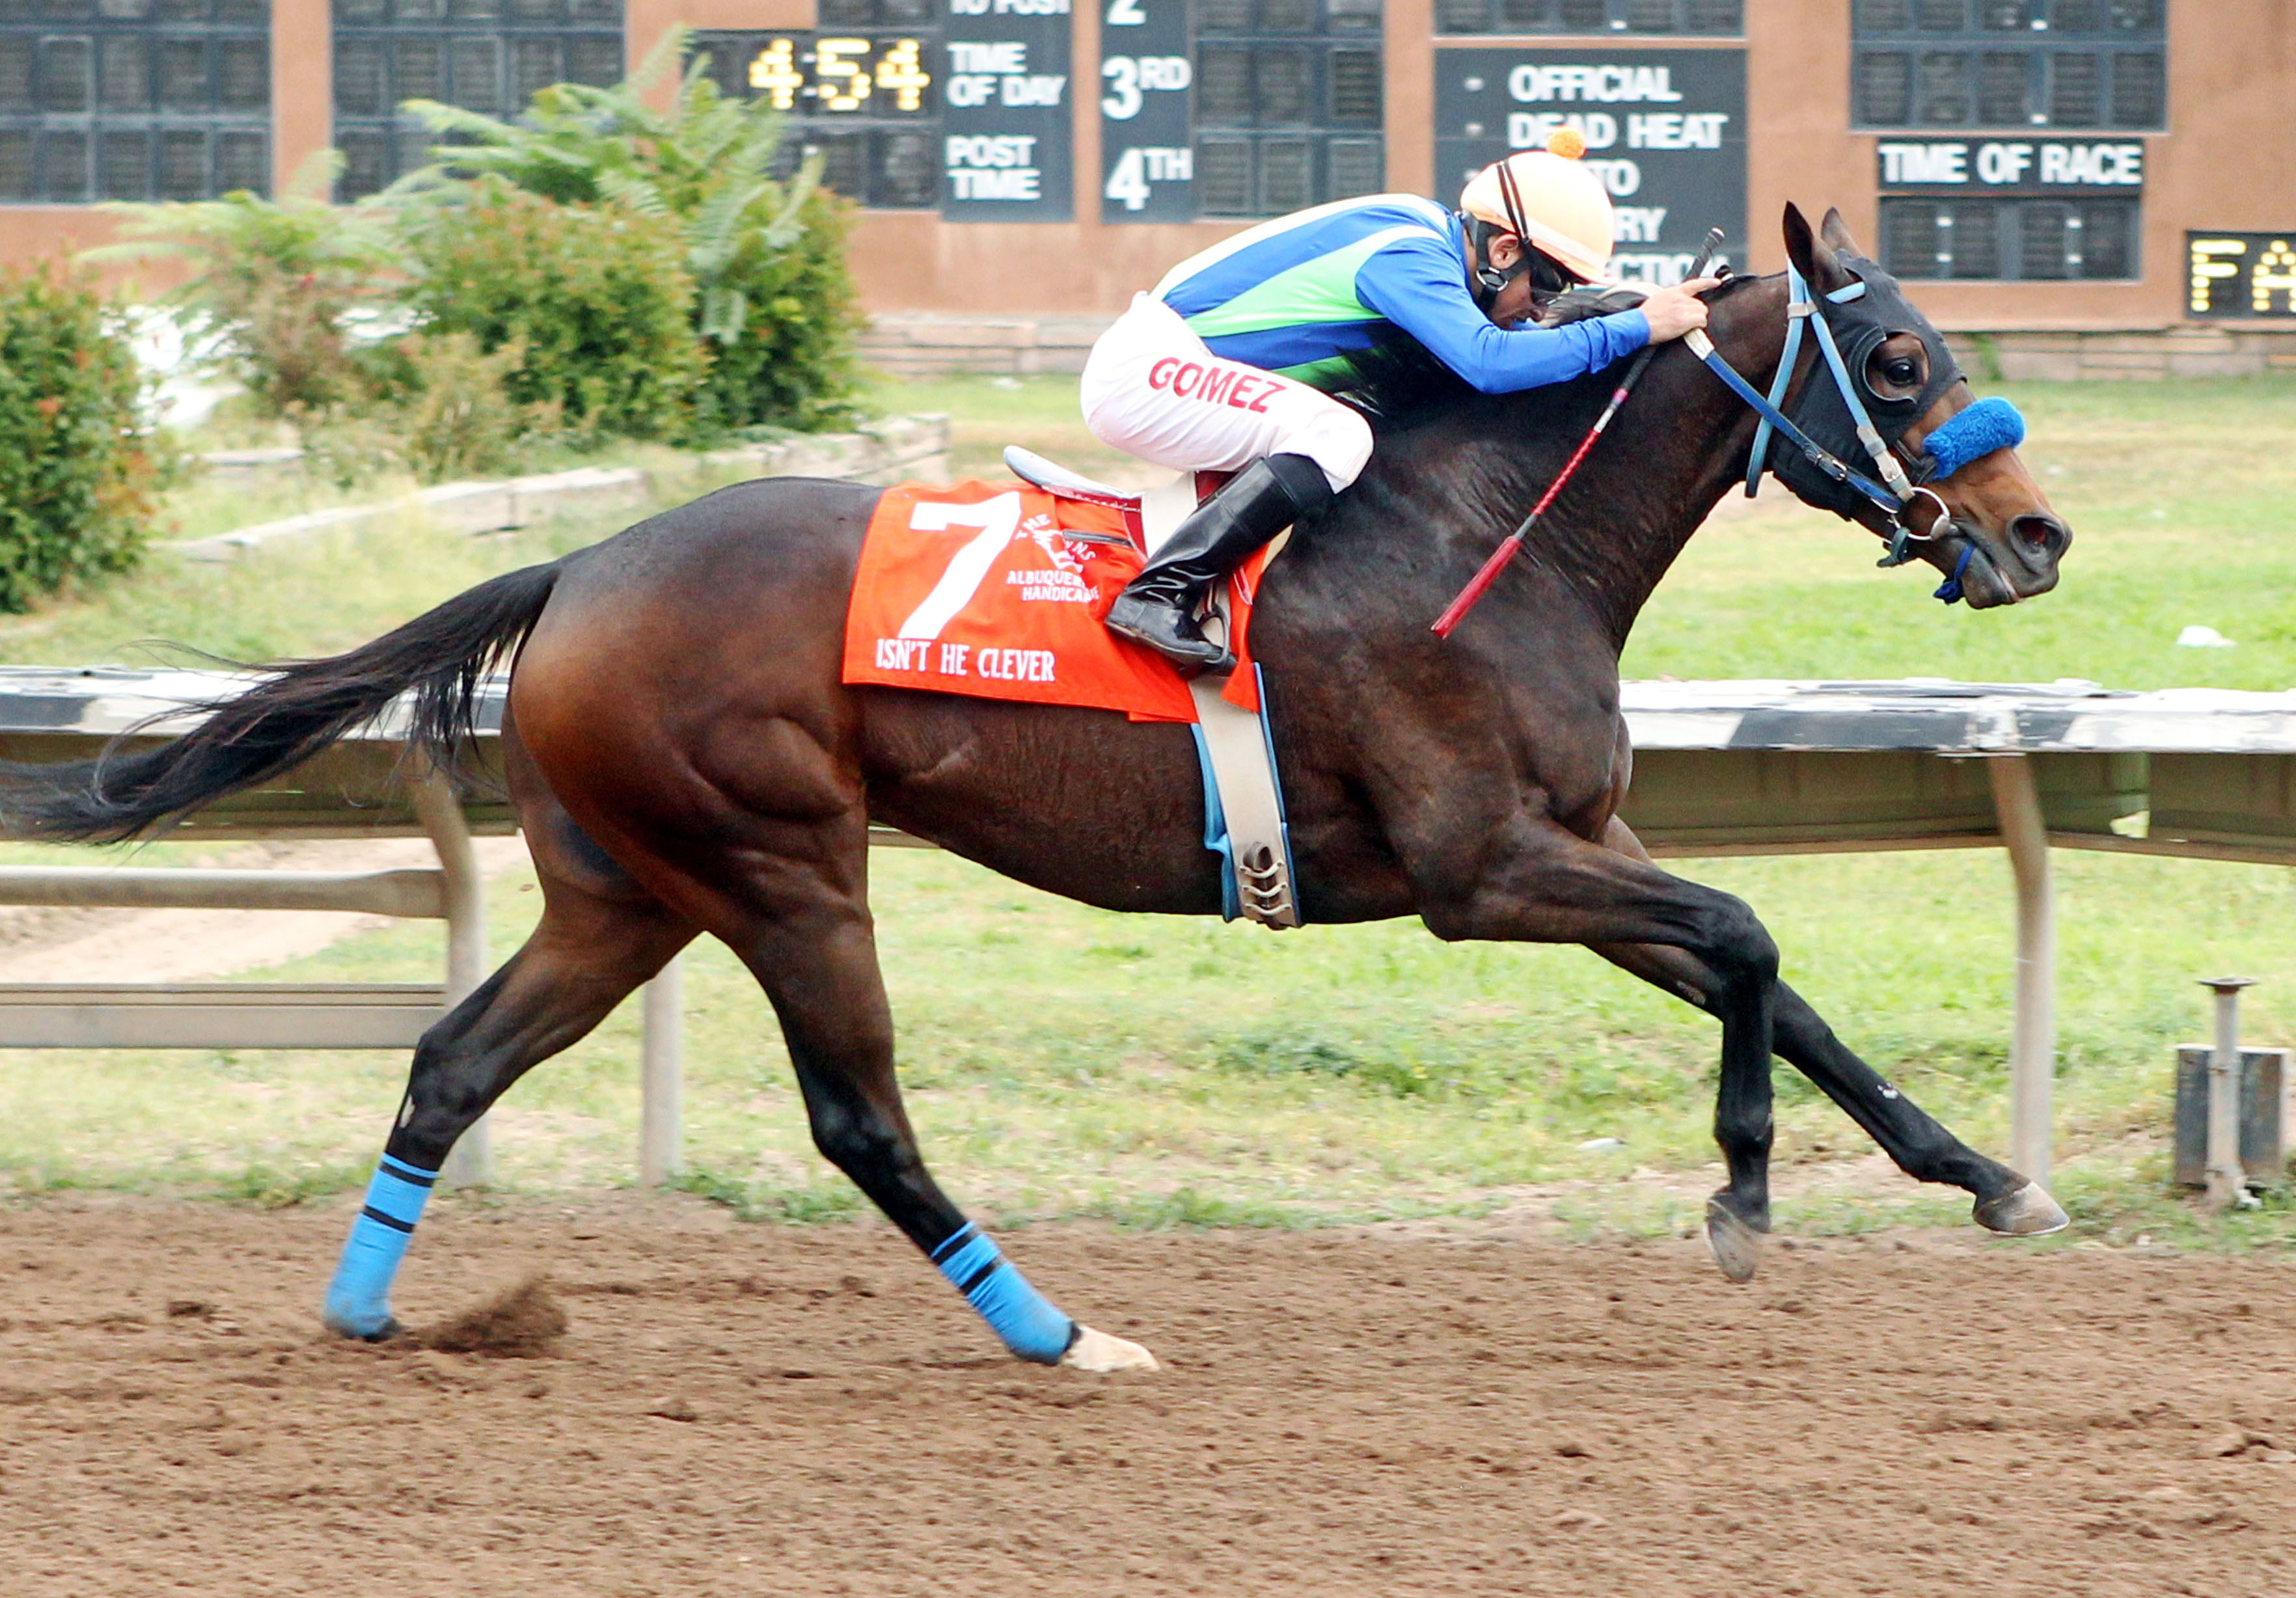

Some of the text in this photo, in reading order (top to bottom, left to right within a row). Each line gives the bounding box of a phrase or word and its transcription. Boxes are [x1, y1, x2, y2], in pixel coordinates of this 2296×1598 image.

[749, 38, 931, 111] 4:54
[946, 42, 1027, 74] TIME
[947, 74, 1067, 107] OF DAY
[1101, 55, 1193, 120] 3RD
[1509, 65, 1684, 102] OFFICIAL
[1628, 113, 1730, 150] HEAT
[946, 135, 1037, 167] POST
[1878, 142, 2143, 185] TIME OF RACE
[947, 167, 1042, 200] TIME
[1106, 146, 1194, 211] 4TH
[1149, 357, 1288, 414] GOMEZ
[1015, 513, 1051, 540] THE
[897, 491, 1022, 640] 7
[1006, 569, 1087, 589] ALBUQUER
[875, 638, 1056, 682] ISN'T HE CLEVER
